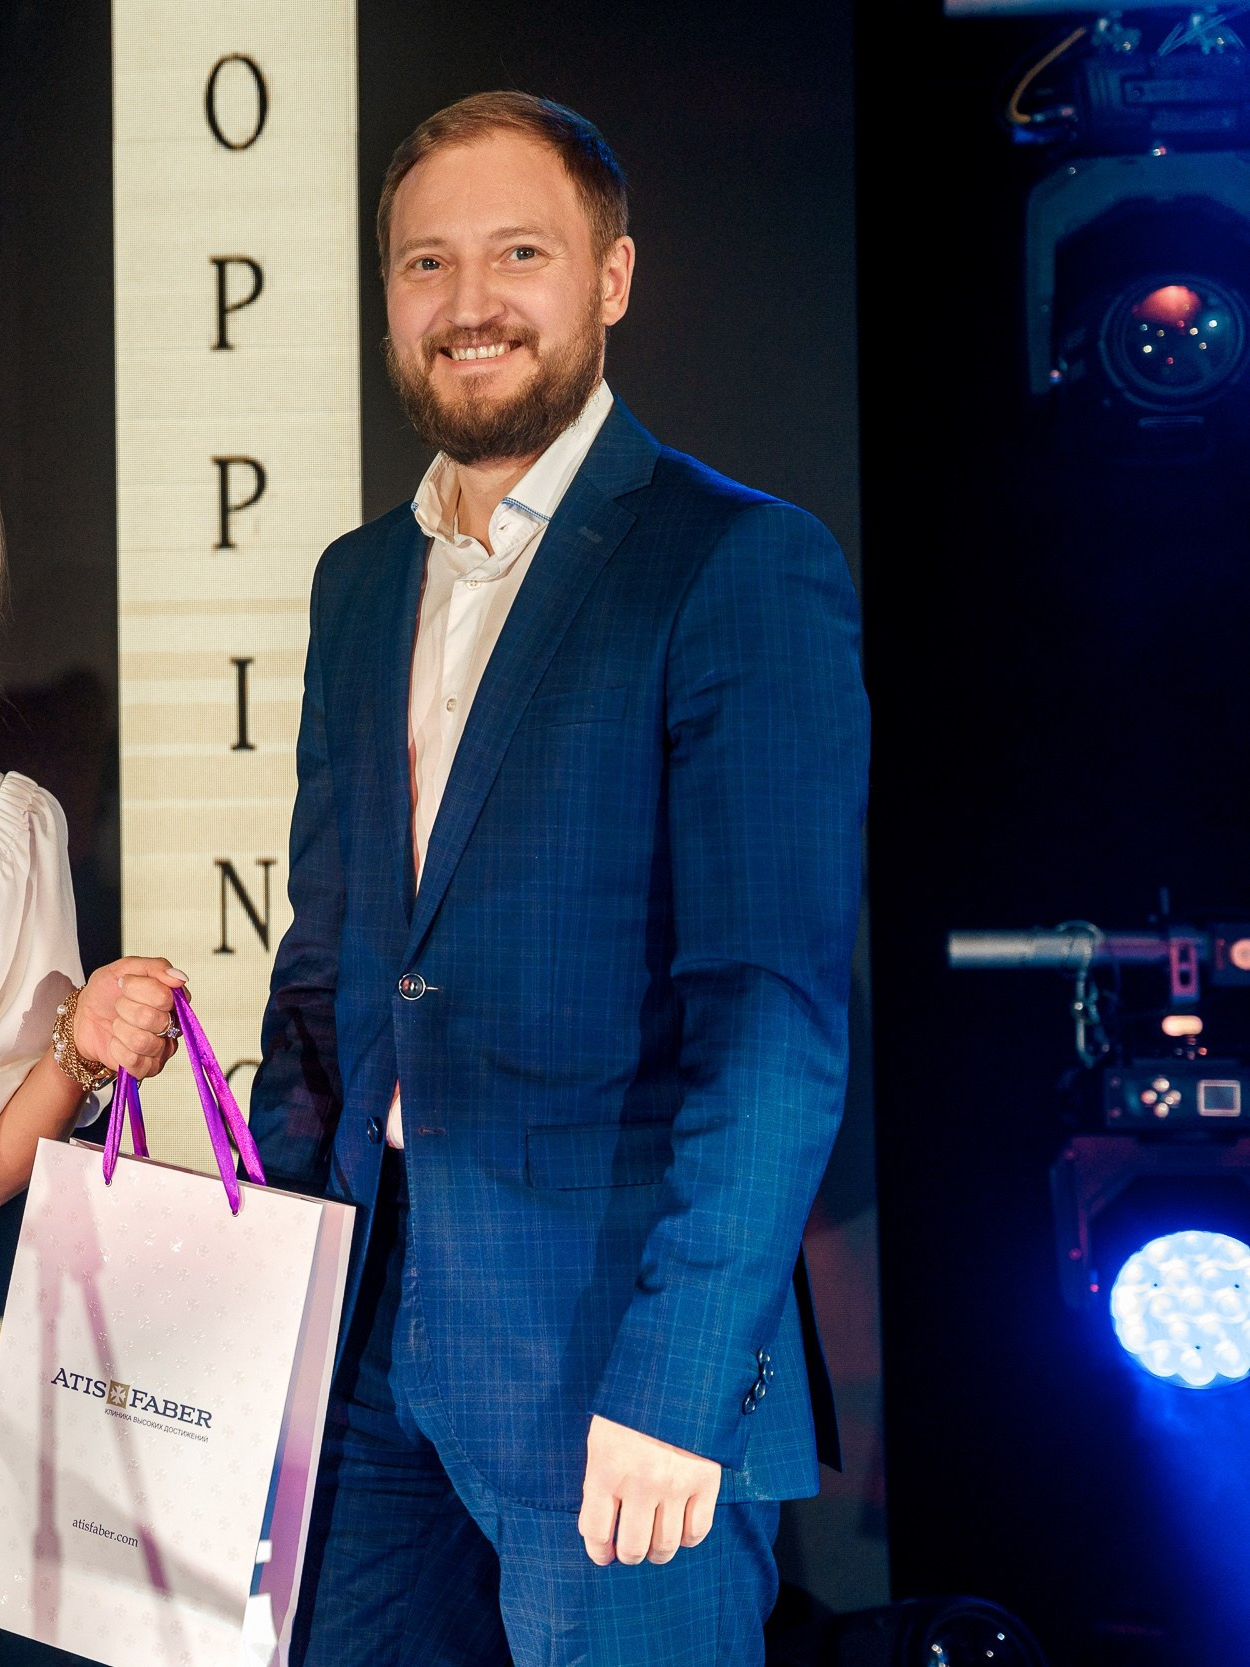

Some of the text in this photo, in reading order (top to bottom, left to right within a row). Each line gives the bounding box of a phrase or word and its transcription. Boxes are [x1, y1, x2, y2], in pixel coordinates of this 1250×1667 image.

[51, 1367, 213, 1429] ATIS FABER
[104, 1408, 209, 1443] КЛИНИКА ВЫСОКИХ ДОСТИЖЕНИЙ
[72, 1518, 139, 1548] atisfaber.com
